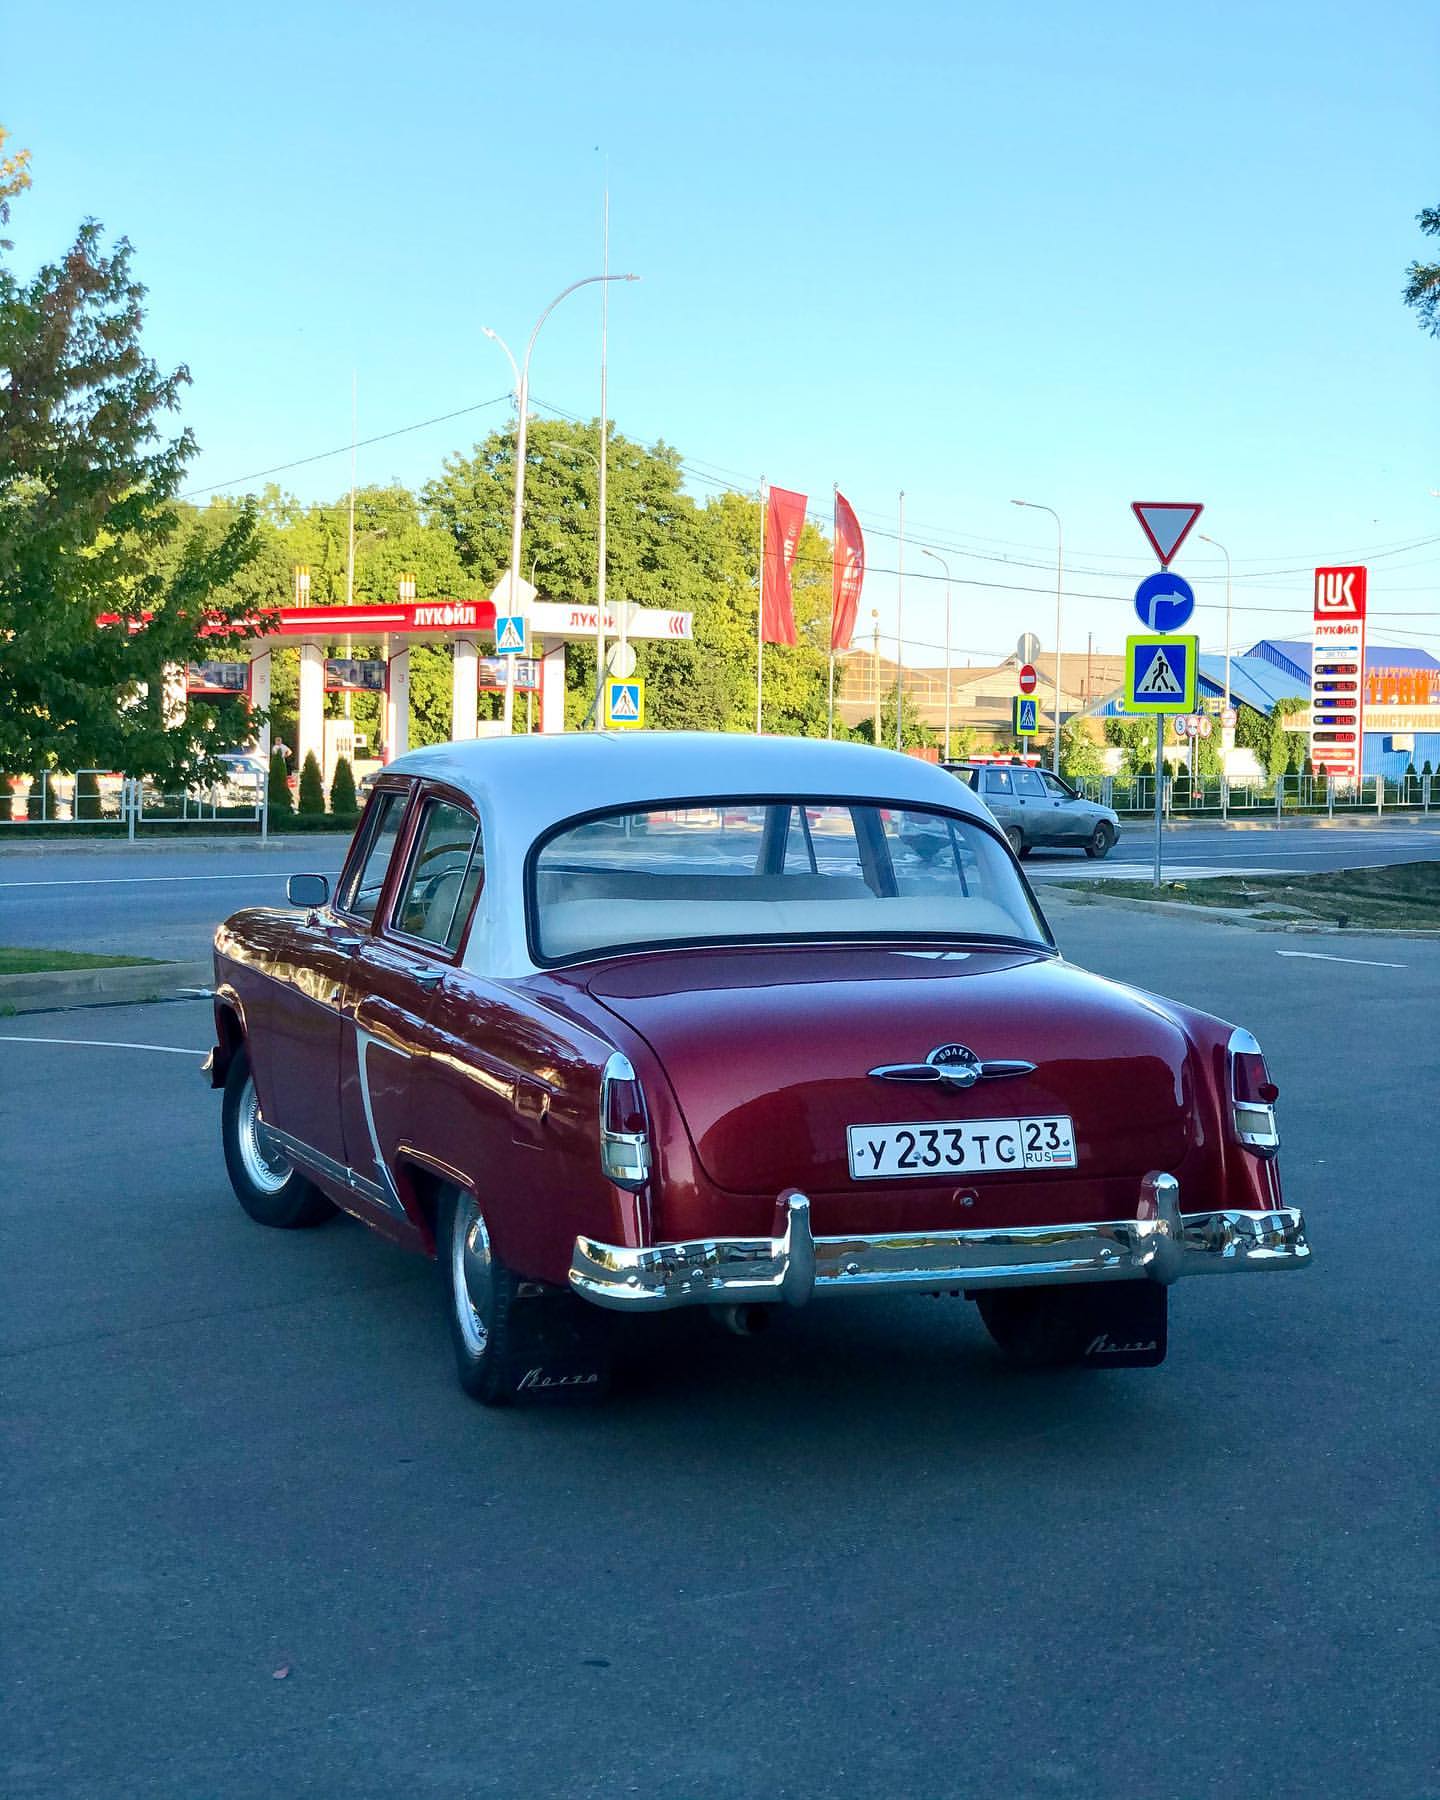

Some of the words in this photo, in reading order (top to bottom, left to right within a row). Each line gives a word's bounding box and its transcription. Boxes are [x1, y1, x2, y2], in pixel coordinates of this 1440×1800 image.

[413, 601, 477, 626] ЛУКОЙЛ
[1315, 623, 1359, 635] ЛУКОЙЛ
[1025, 1122, 1061, 1151] 23
[1025, 1152, 1052, 1163] RUS
